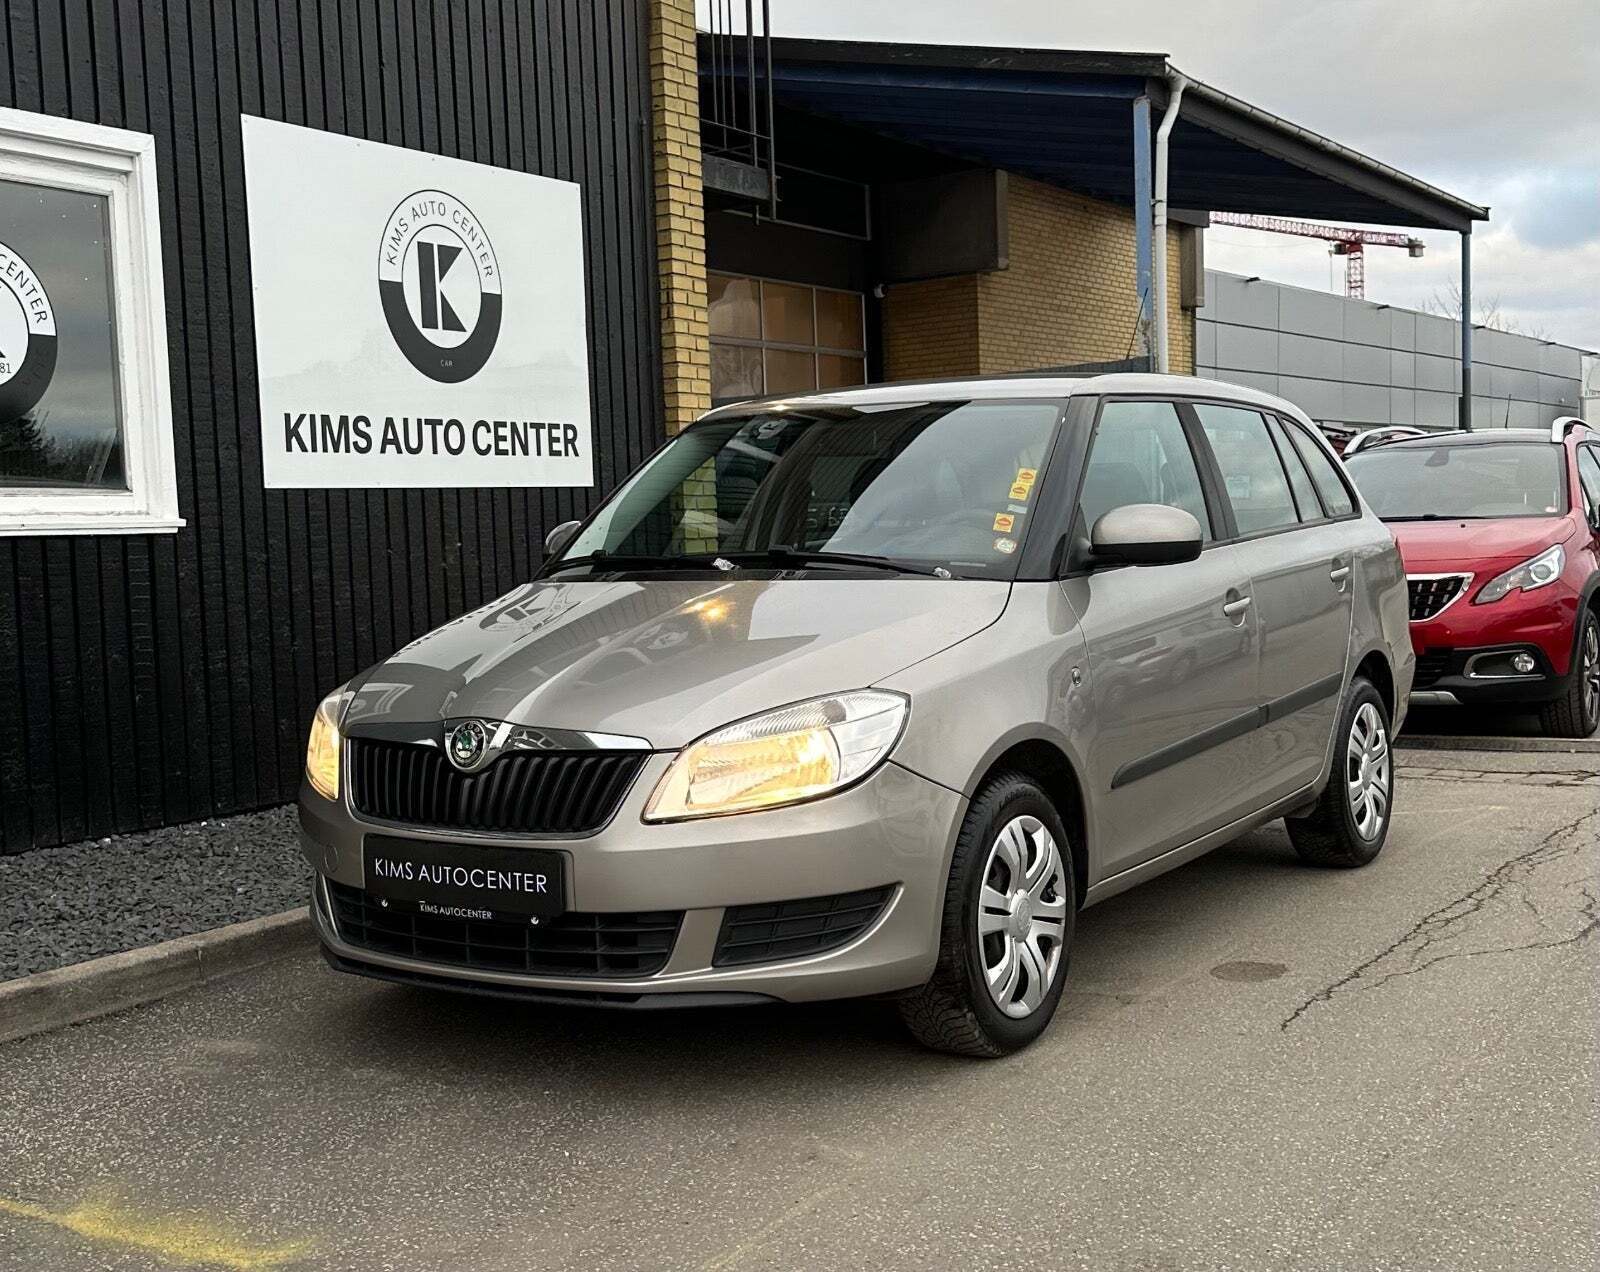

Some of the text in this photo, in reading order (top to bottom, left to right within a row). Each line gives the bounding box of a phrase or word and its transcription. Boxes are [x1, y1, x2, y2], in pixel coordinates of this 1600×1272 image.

[386, 200, 493, 278] KIMS AUTO CENTER
[284, 412, 580, 457] KIMS AUTO CENTER
[375, 858, 547, 893] KIMS AUTOCENTER
[420, 902, 492, 919] KIMS AUTOCENTER
